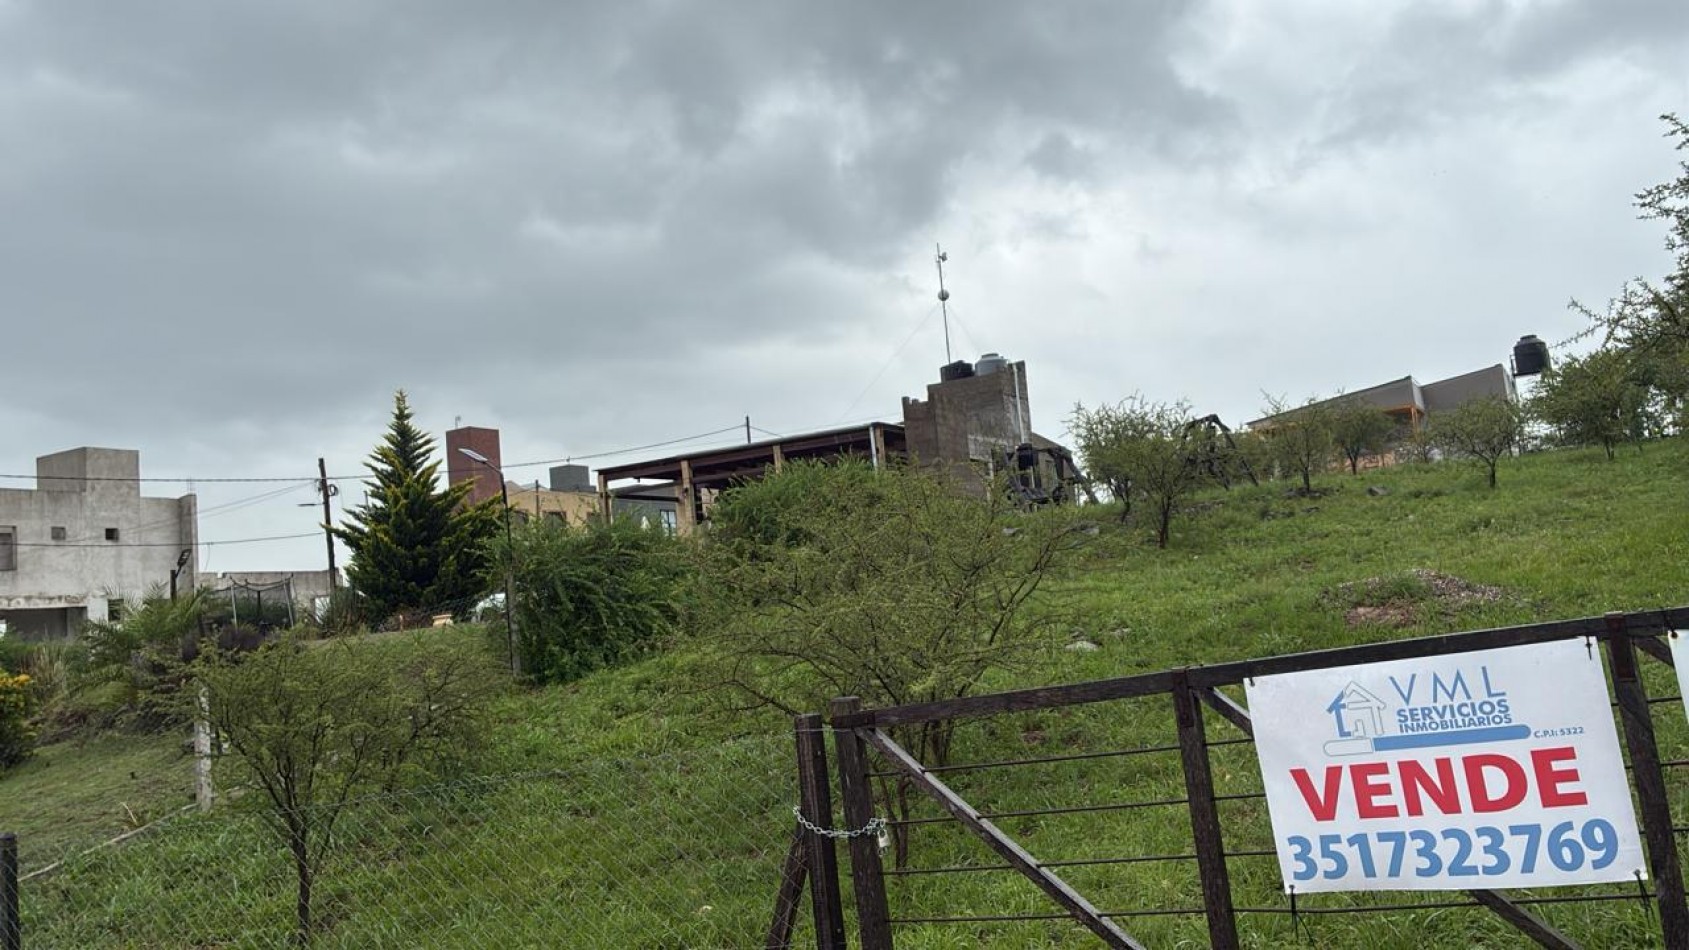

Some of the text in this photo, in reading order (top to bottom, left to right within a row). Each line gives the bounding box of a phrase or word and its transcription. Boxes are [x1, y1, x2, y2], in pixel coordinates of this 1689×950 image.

[1389, 666, 1506, 705] VML
[1397, 699, 1509, 723] SERVICIOS
[1399, 714, 1512, 733] INMOBILIARIOS
[1560, 726, 1584, 736] 5322
[1289, 746, 1588, 822] VENDE
[1287, 818, 1618, 881] 3517323769
